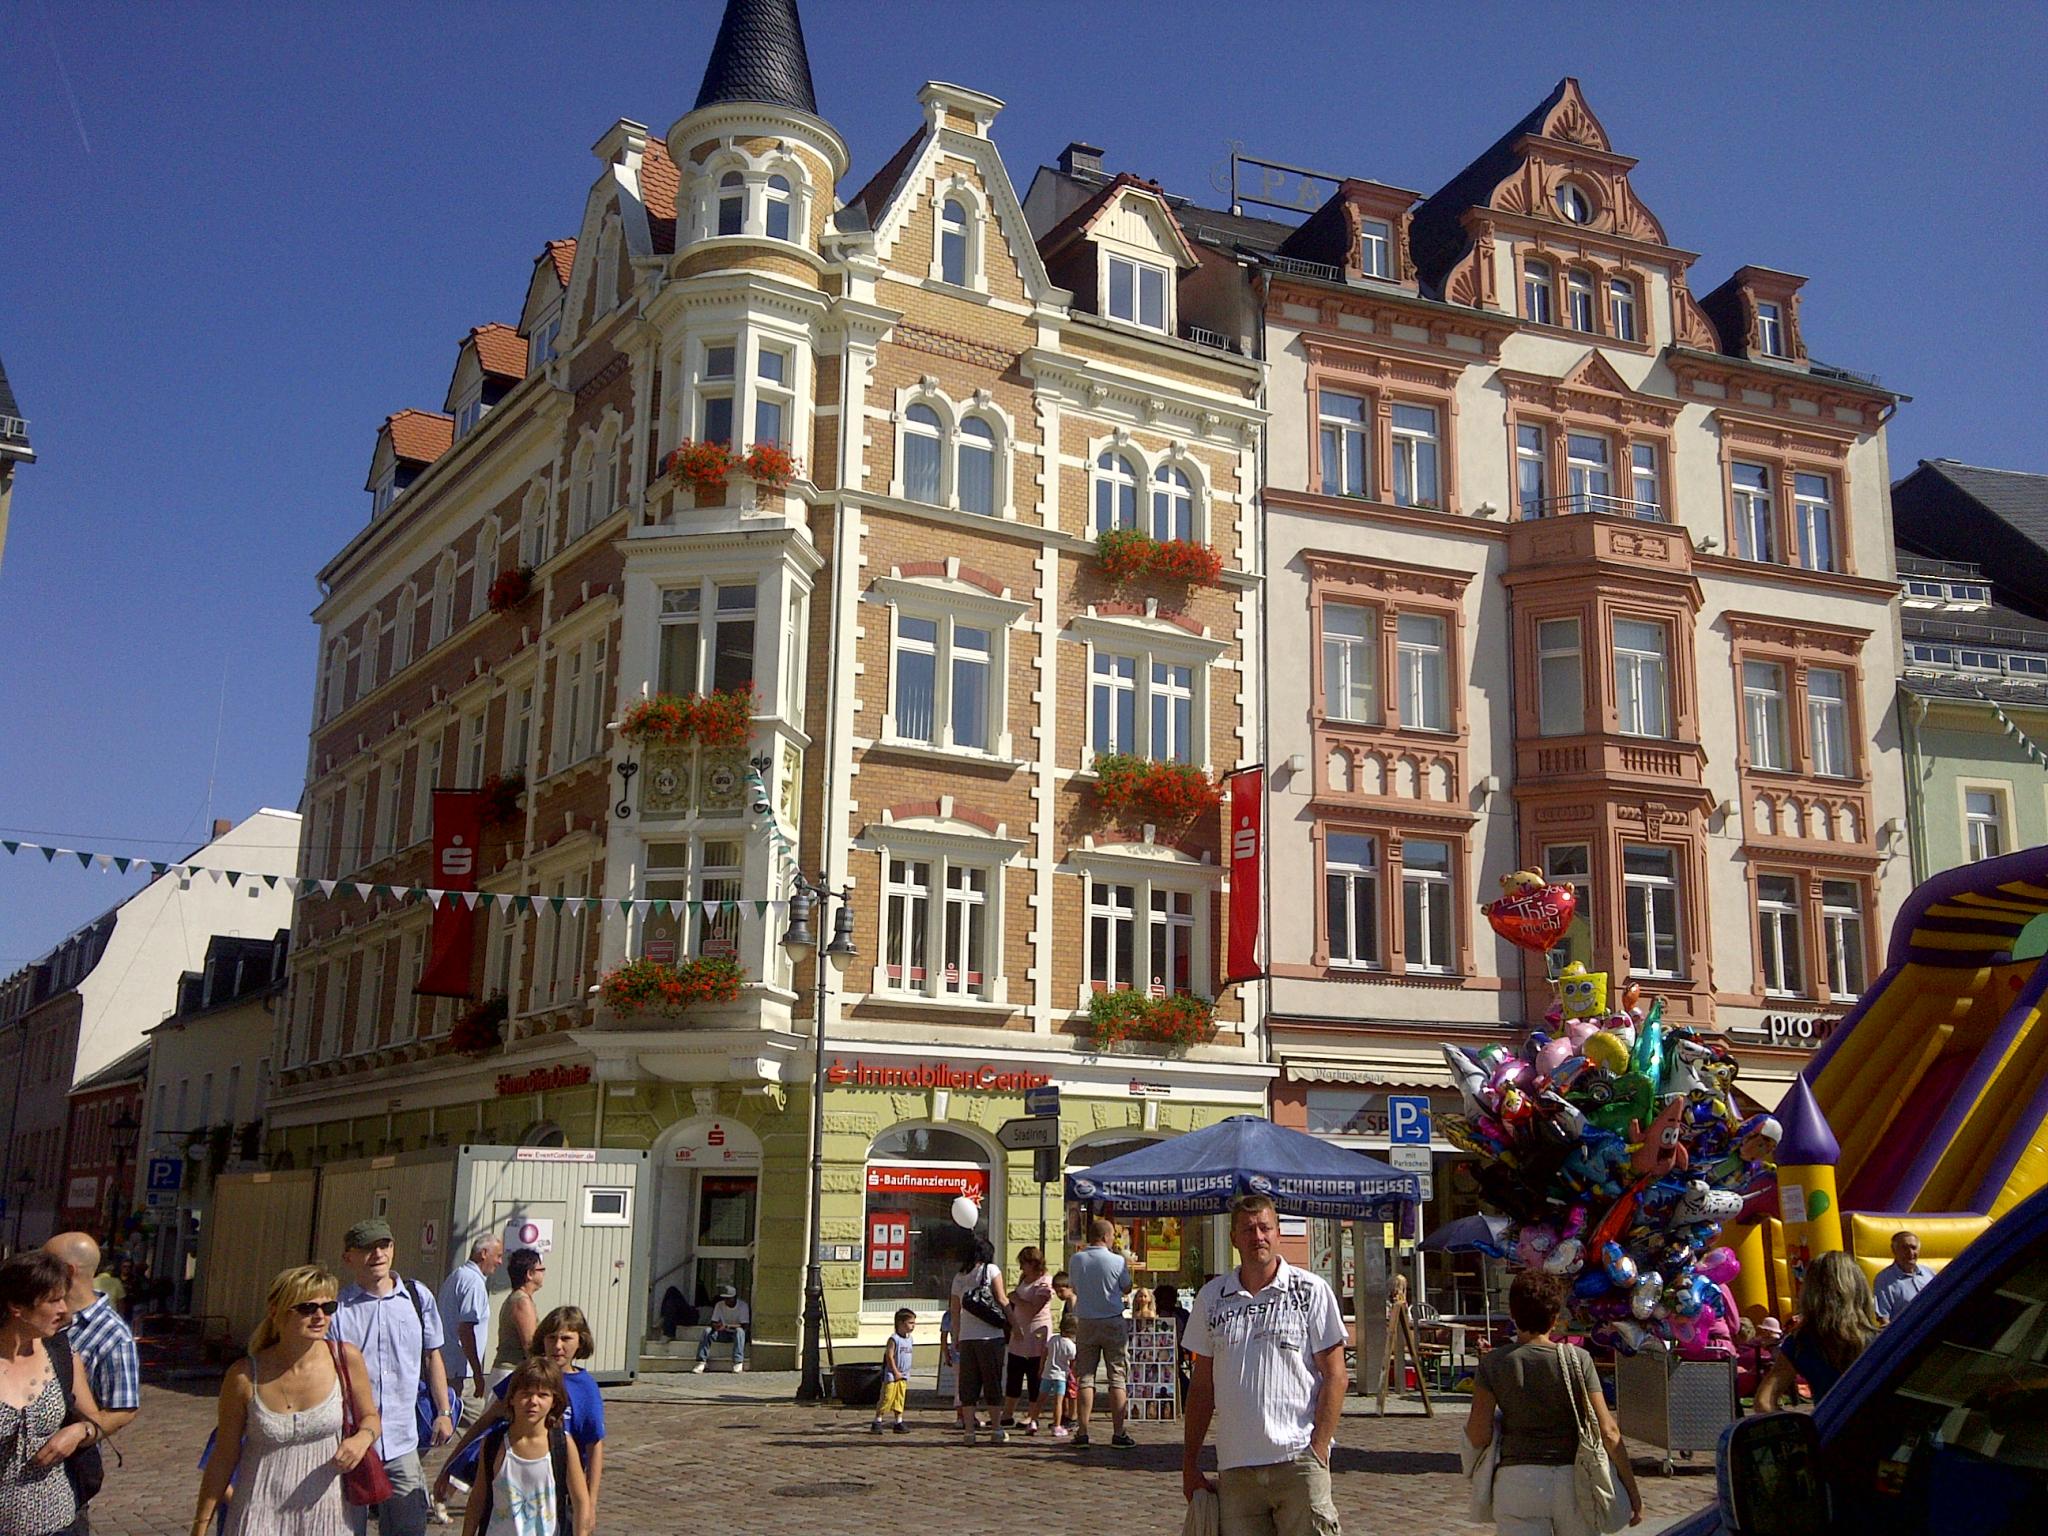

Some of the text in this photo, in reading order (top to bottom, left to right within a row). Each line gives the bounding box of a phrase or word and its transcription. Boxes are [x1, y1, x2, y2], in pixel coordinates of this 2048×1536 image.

[1507, 900, 1559, 920] This
[1395, 1102, 1417, 1138] P
[153, 1162, 172, 1186] P
[1394, 1160, 1428, 1168] Parkschein
[1102, 1175, 1233, 1195] SCHNEIDER WEISSE
[1278, 1179, 1413, 1195] SCHNEIDER WEISSE
